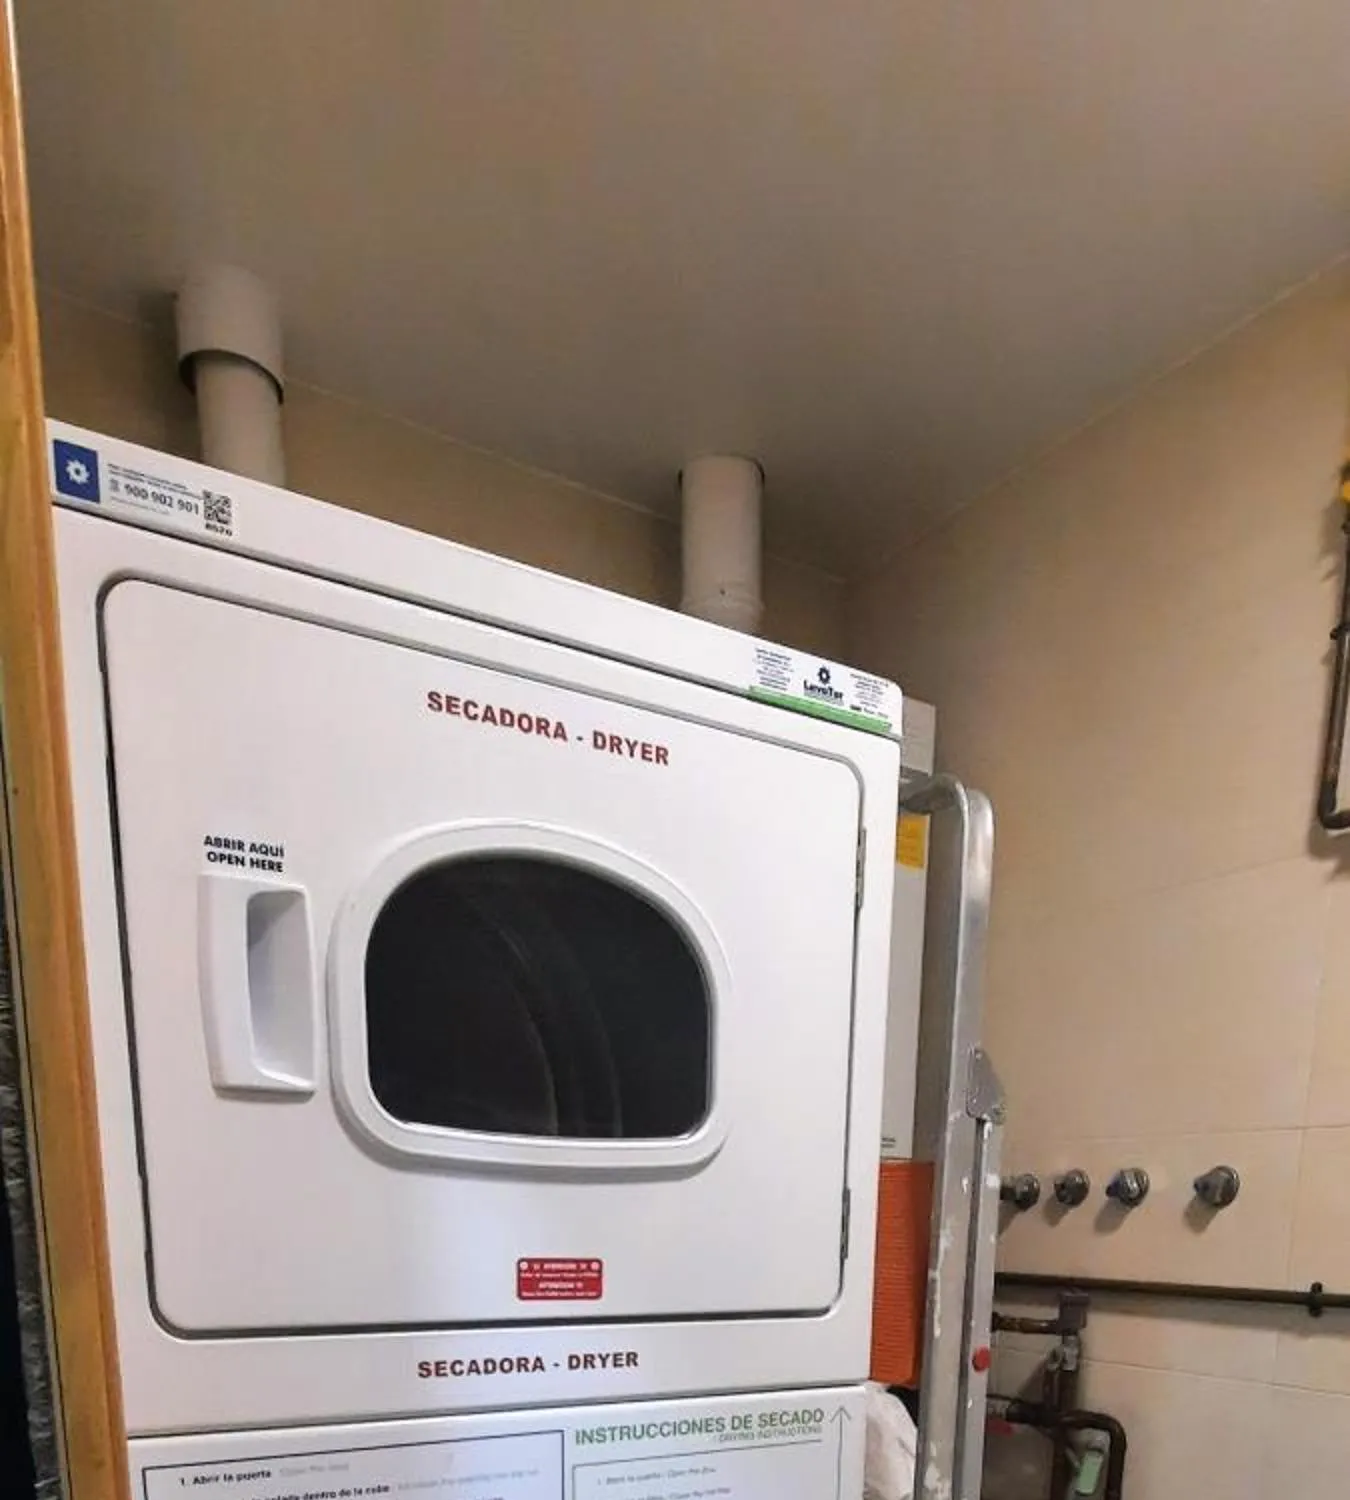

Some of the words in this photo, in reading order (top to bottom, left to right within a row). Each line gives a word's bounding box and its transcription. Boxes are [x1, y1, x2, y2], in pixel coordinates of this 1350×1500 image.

[124, 483, 149, 499] 900
[151, 491, 174, 508] 902
[177, 499, 199, 515] 901
[427, 691, 568, 742] SECADORA
[592, 730, 670, 765] DRYER
[204, 835, 245, 852] ABRIR
[207, 851, 245, 867] OPEN
[249, 857, 284, 873] HERE
[418, 1356, 546, 1378] SECADORA
[567, 1351, 639, 1370] DRYER
[575, 1416, 726, 1446] INSTRUCCIONES
[731, 1413, 753, 1431] DE
[757, 1408, 825, 1428] SECADO
